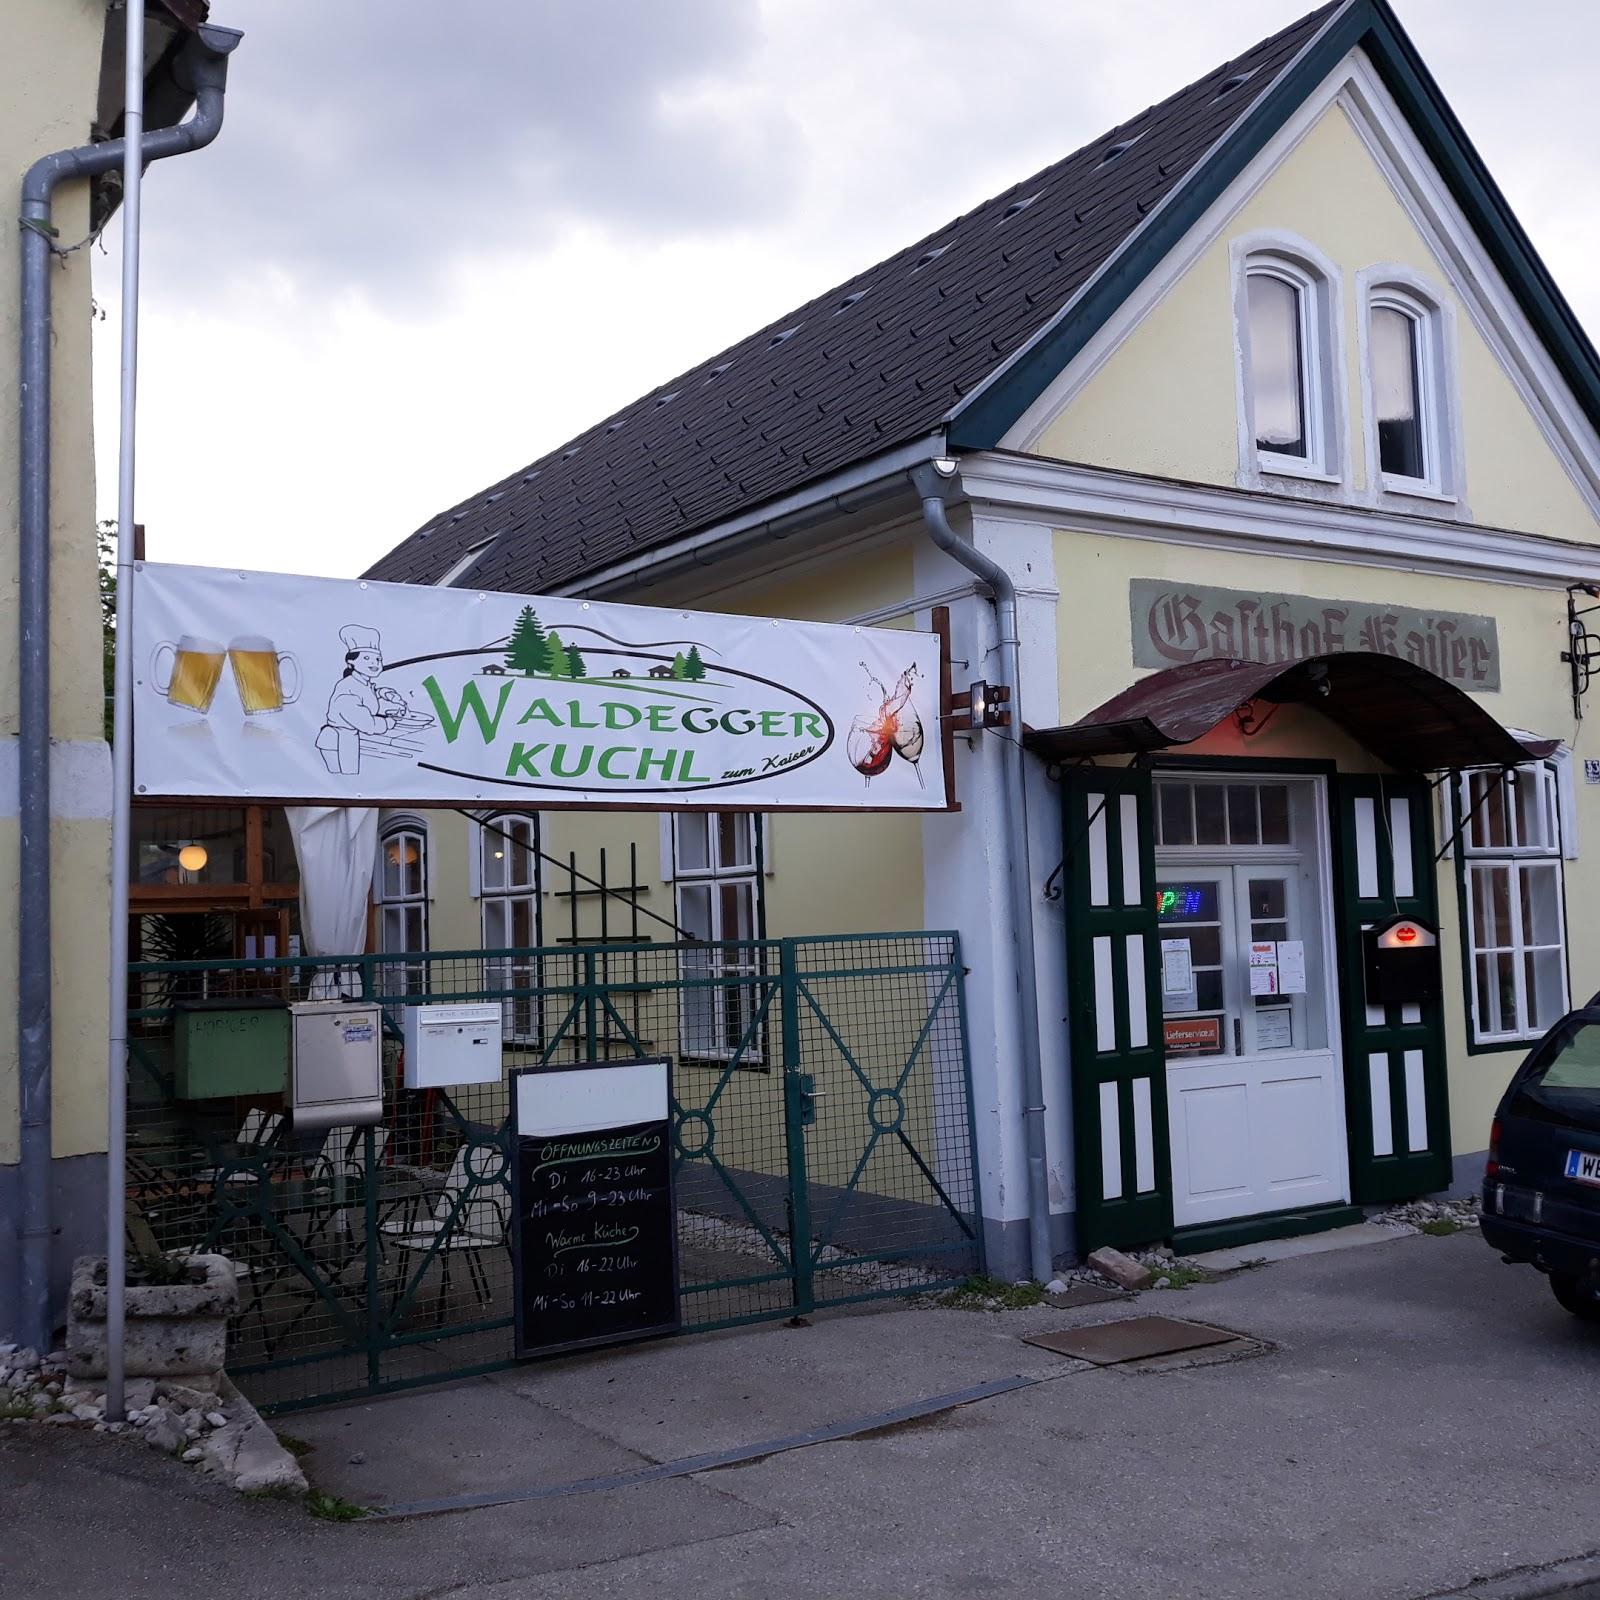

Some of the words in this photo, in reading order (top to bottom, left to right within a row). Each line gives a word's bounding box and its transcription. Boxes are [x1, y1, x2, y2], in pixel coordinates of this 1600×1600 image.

[422, 675, 826, 745] WALDEGGER
[505, 742, 711, 783] KUCHL
[721, 766, 755, 779] zum
[761, 745, 815, 772] Kaiser
[548, 1171, 568, 1189] Di
[625, 1165, 647, 1177] Uhr
[629, 1188, 652, 1202] Uhr
[546, 1229, 585, 1249] Warme
[594, 1221, 627, 1240] Küche
[544, 1263, 565, 1278] Di
[616, 1256, 638, 1270] Uhr
[619, 1289, 641, 1302] Uhr
